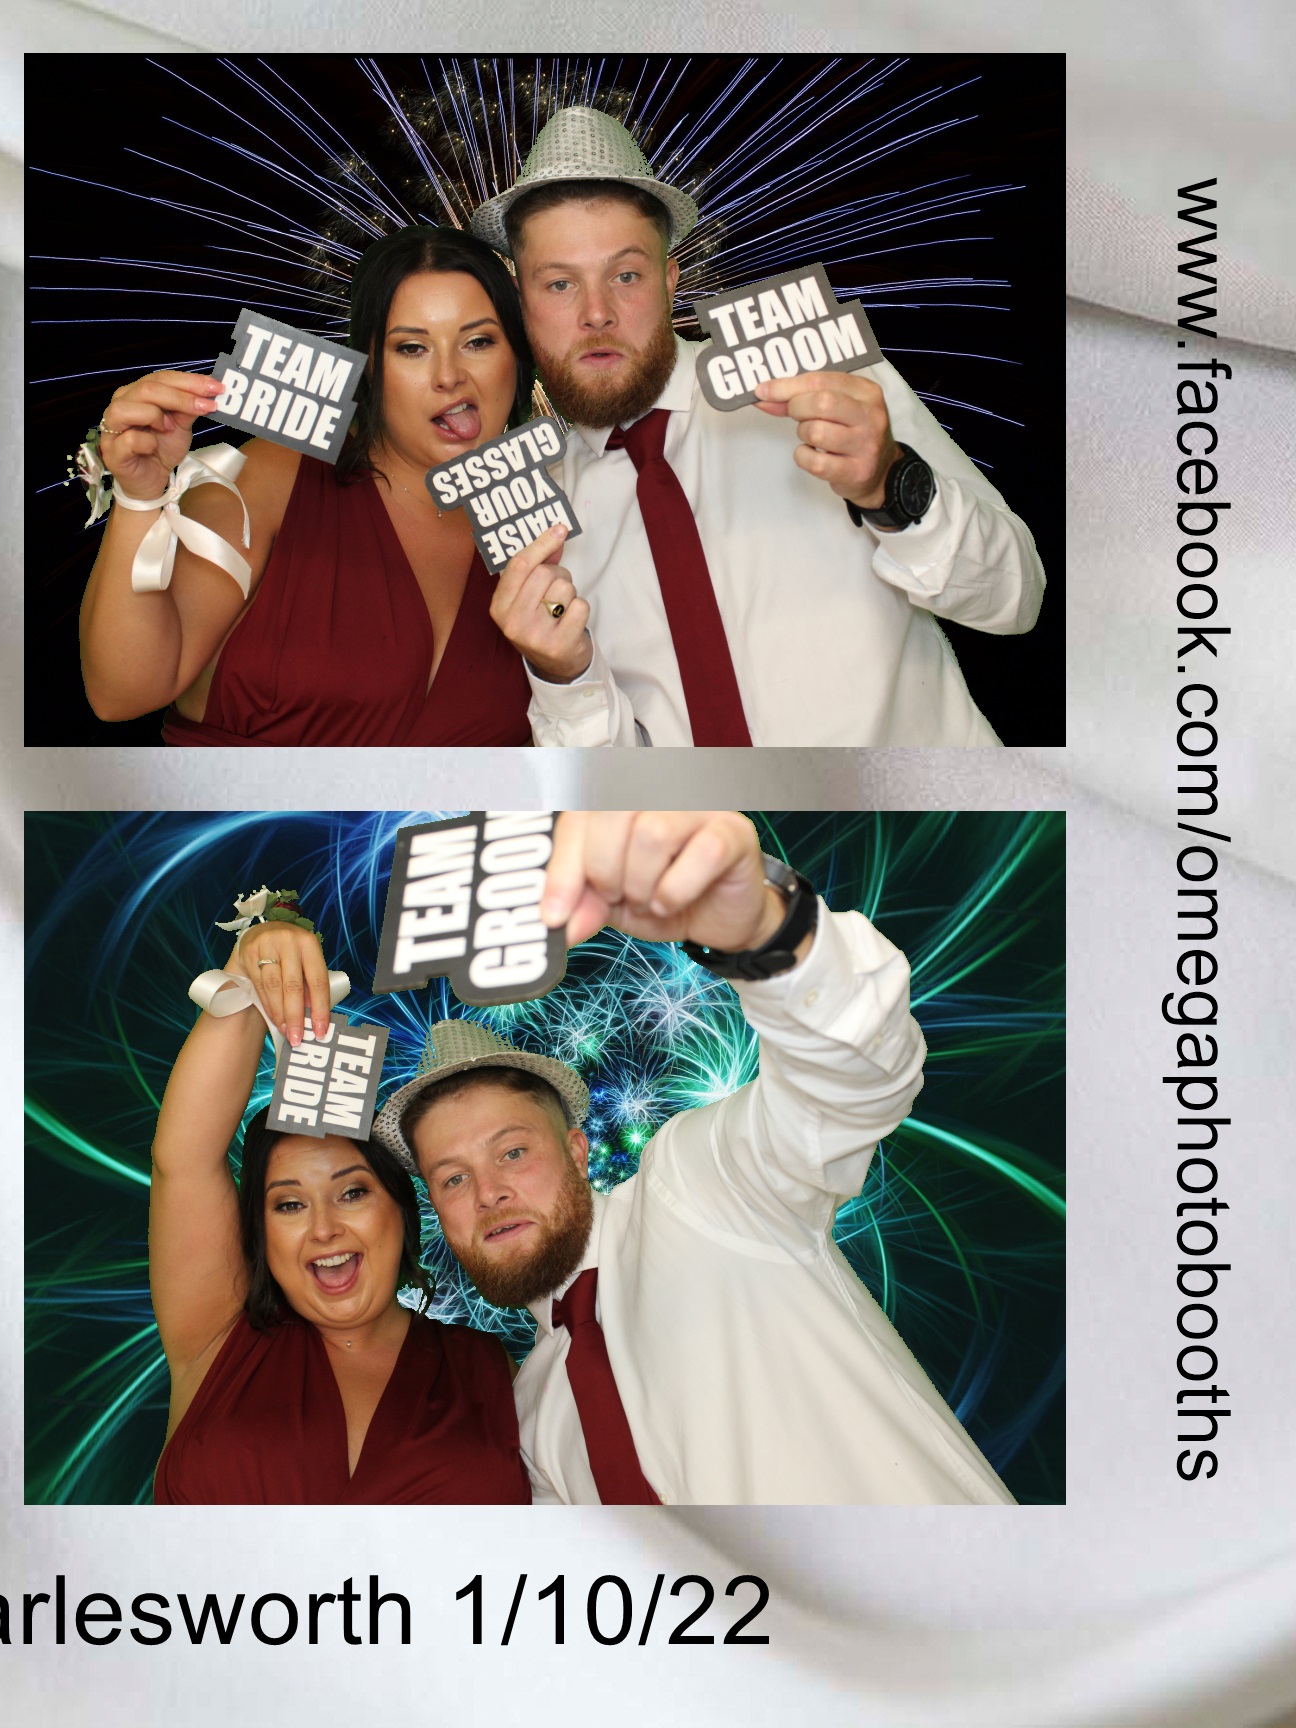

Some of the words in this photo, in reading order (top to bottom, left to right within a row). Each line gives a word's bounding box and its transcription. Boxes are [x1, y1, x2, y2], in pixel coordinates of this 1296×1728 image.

[708, 276, 829, 347] TEAM
[240, 324, 353, 403] TEAM
[707, 313, 868, 400] GROOM
[215, 368, 342, 450] BRIDE
[432, 422, 561, 504] GLASSES
[469, 468, 556, 528] YOUR
[393, 824, 478, 974] TEAM
[322, 1034, 377, 1130] TEAM
